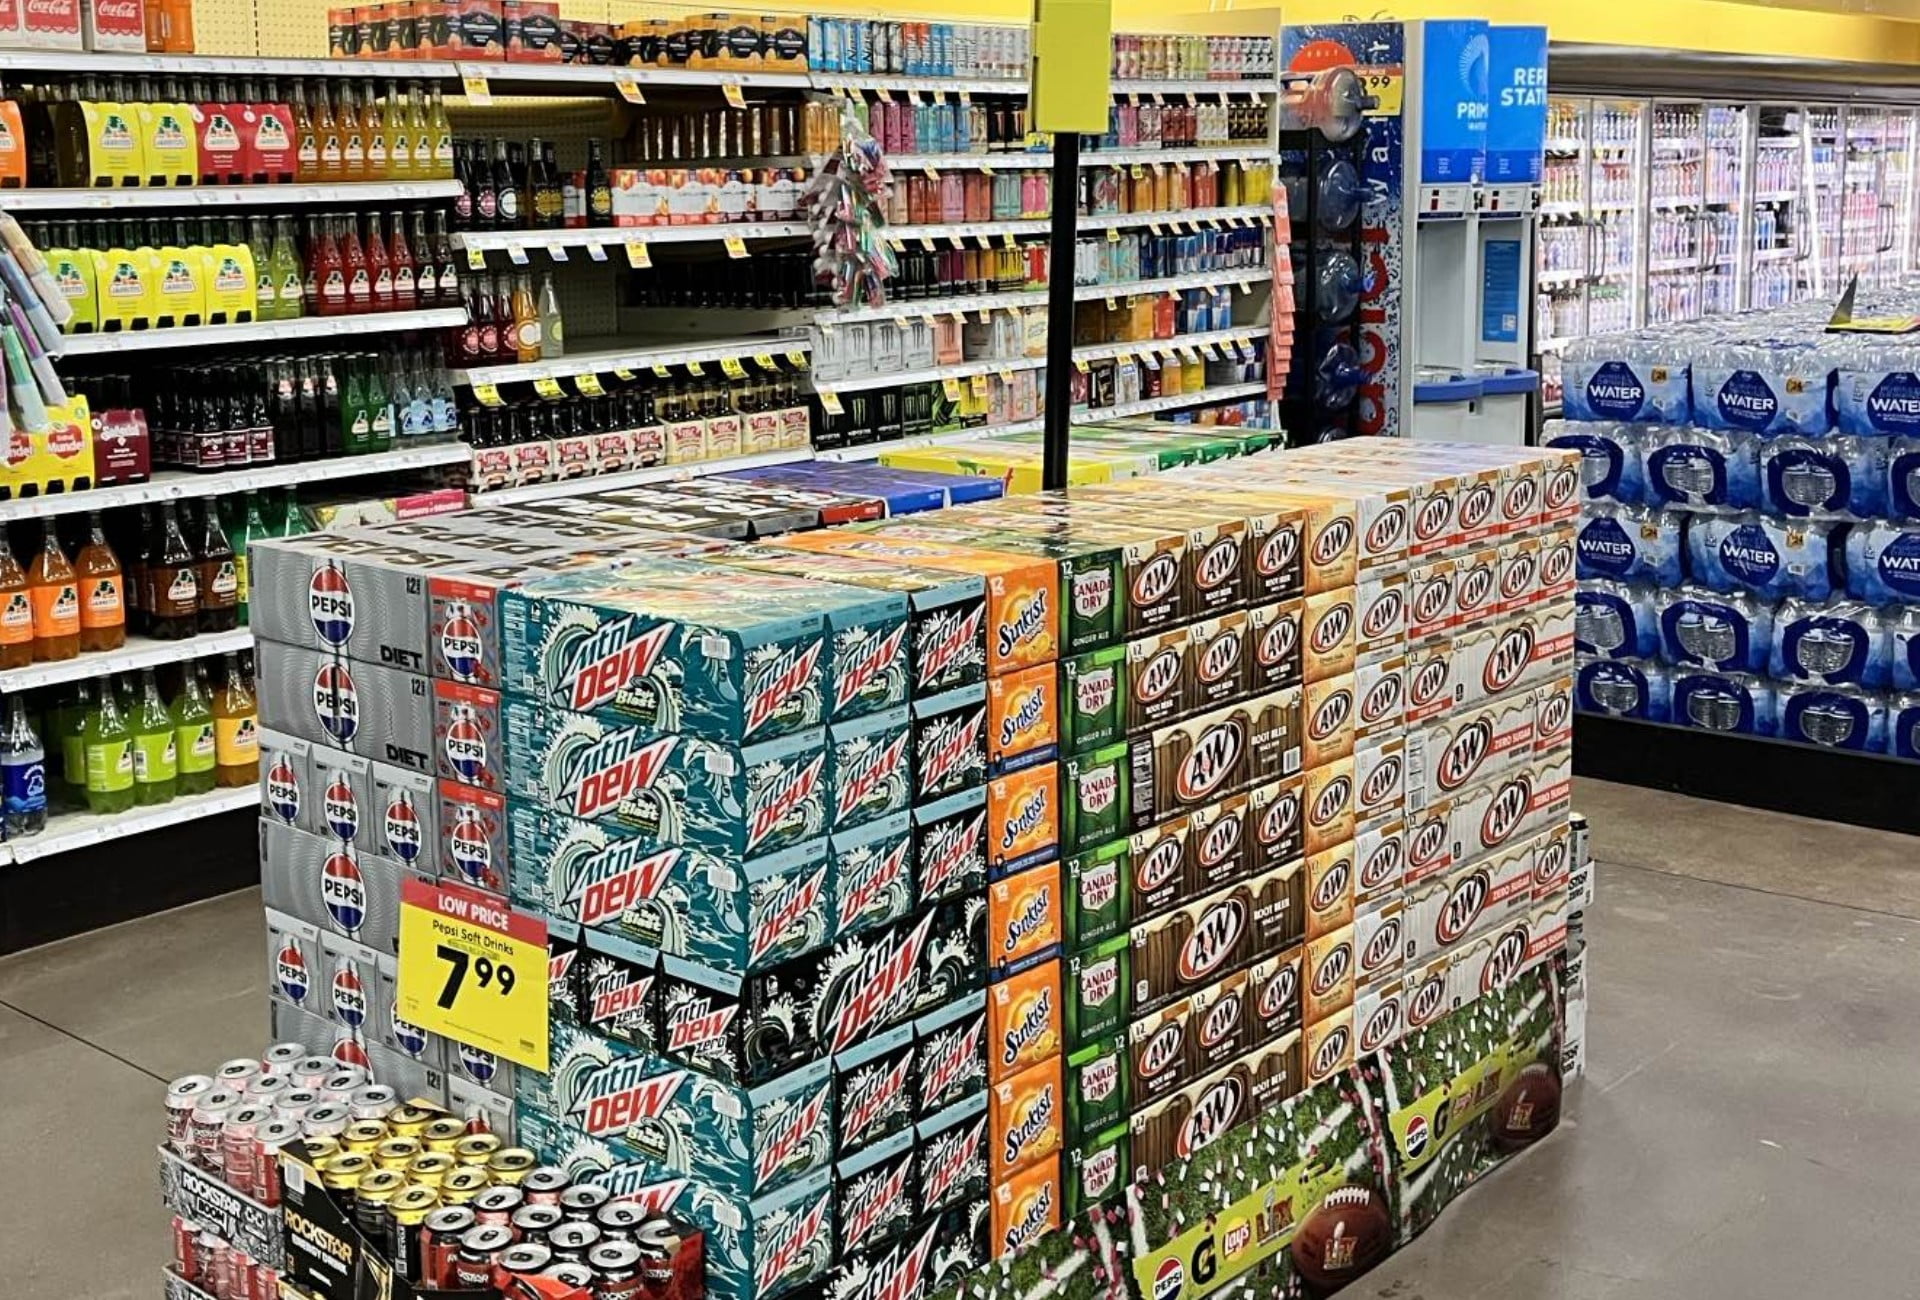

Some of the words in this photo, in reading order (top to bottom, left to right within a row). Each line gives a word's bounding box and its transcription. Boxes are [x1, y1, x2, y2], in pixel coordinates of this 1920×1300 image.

[1590, 386, 1641, 400] WATER
[1721, 394, 1774, 411] WATER
[1579, 539, 1631, 555] WATER
[1723, 546, 1776, 565] WATER
[1061, 561, 1073, 575] 12
[1073, 578, 1112, 598] CANADA
[311, 594, 353, 618] PEPSI
[1081, 597, 1102, 610] DRY
[998, 587, 1047, 657] Sunkist
[380, 644, 423, 669] DIET
[444, 638, 480, 655] PEPSI
[1065, 662, 1077, 675] 12
[1077, 677, 1115, 697] CANADA
[1085, 695, 1105, 710] DRY
[1000, 685, 1044, 746] Sunkist
[385, 743, 429, 770] DIET
[449, 739, 484, 759] PEPSI
[1067, 762, 1079, 776] 12
[269, 784, 297, 803] PEPSI
[1079, 775, 1118, 798] CANADA
[1089, 793, 1109, 809] DRY
[326, 803, 356, 822] PEPSI
[1002, 786, 1046, 849] Sunkist
[387, 821, 419, 841] PEPSI
[454, 839, 489, 860] PEPSI
[1068, 860, 1080, 874] 12
[324, 878, 364, 906] PEPSI
[1080, 873, 1118, 896] CANADA
[1089, 890, 1110, 906] DRY
[438, 893, 469, 915] LOW
[471, 900, 509, 931] PRICE
[1005, 885, 1049, 950] Sunkist
[1253, 905, 1273, 921] ROOT
[1273, 898, 1291, 914] BEER
[432, 919, 461, 937] Pepsi
[461, 927, 482, 946] Soft
[484, 936, 514, 956] Drinks
[278, 962, 308, 985] PEPSI
[1069, 957, 1081, 971] 12
[1080, 969, 1118, 992] CANADA
[334, 989, 364, 1010] PEPSI
[1089, 987, 1110, 1003] DRY
[1005, 986, 1050, 1064] Sunkist
[1114, 1035, 1125, 1049] 12
[1080, 1065, 1118, 1089] CANADA
[1252, 1080, 1270, 1096] ROOT
[1270, 1070, 1287, 1088] BEER
[1089, 1084, 1110, 1099] DRY
[1005, 1084, 1053, 1163] Sunkist
[1406, 1129, 1429, 1147] PEPSI
[1070, 1149, 1082, 1164] 12
[1082, 1157, 1118, 1181] CANADA
[1089, 1175, 1111, 1192] DRY
[182, 1170, 242, 1219] ROCKSTAR
[284, 1207, 352, 1265] ROCKSTAR
[1191, 1235, 1217, 1285] G
[1154, 1271, 1183, 1295] PEPSI
